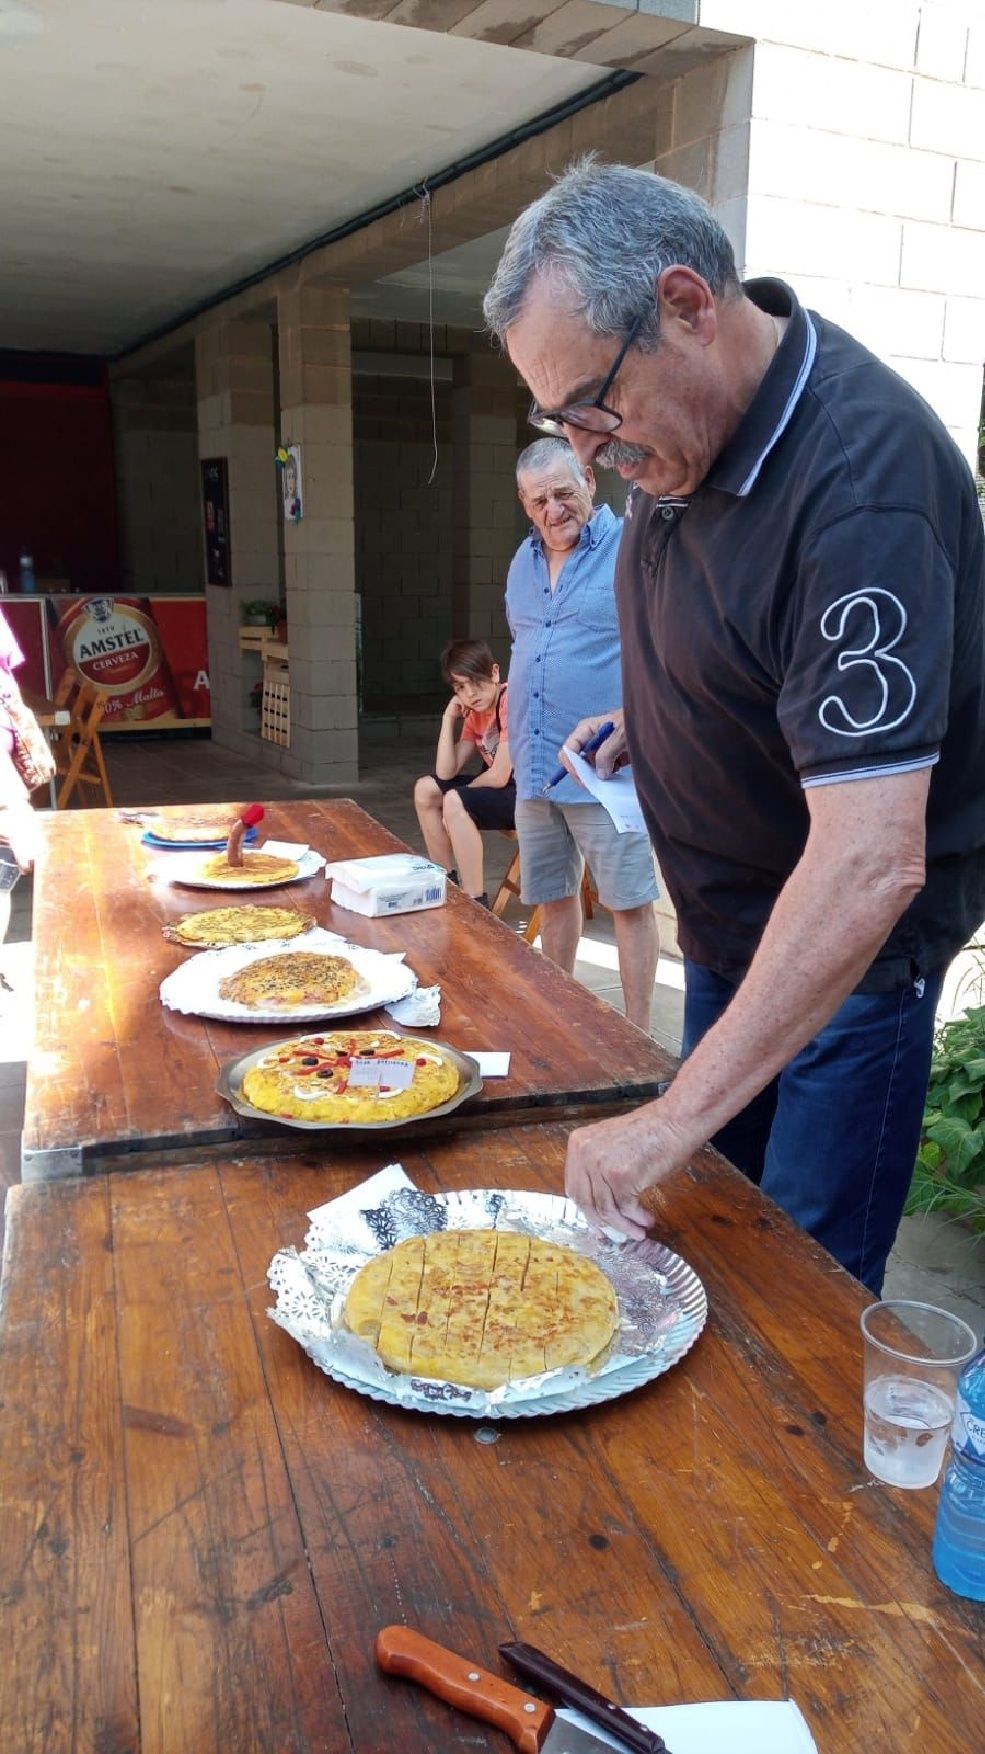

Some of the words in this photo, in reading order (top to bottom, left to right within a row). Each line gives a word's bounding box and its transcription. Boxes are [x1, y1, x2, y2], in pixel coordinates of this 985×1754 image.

[80, 629, 144, 659] AMSTEL
[92, 651, 139, 671] CERVEZA
[818, 586, 916, 737] 3
